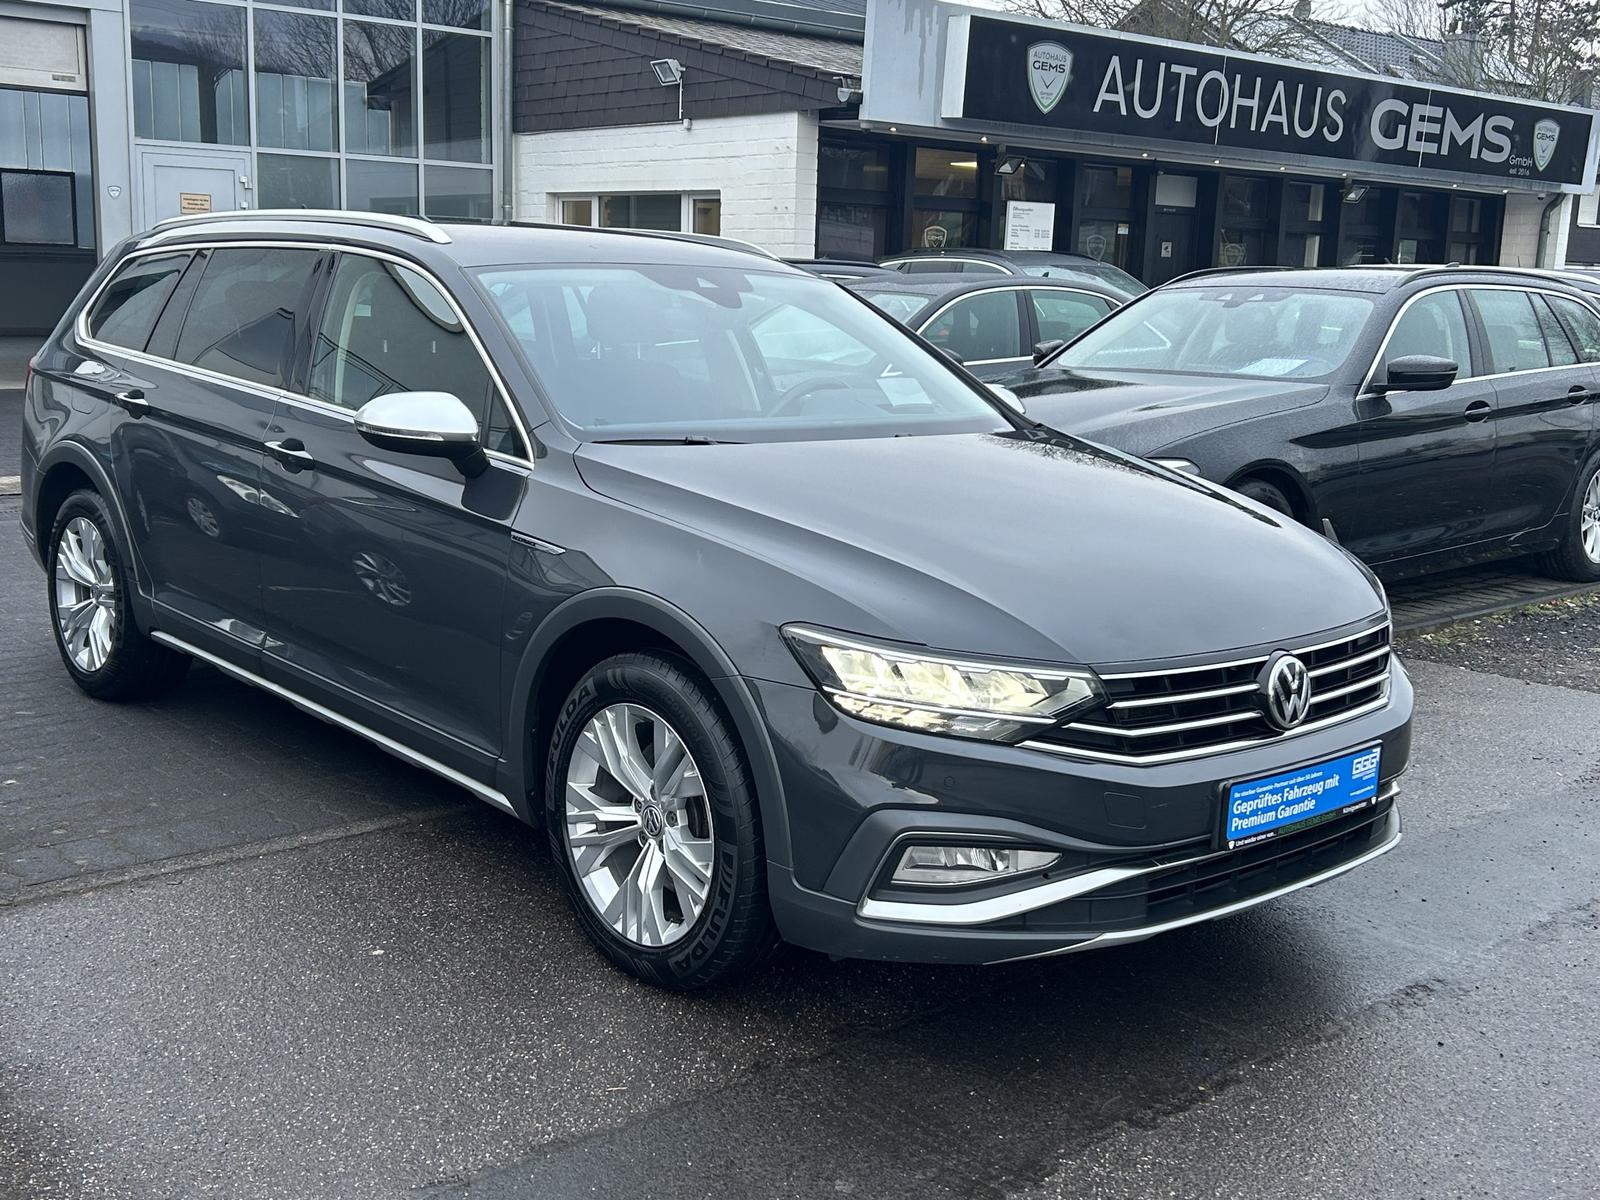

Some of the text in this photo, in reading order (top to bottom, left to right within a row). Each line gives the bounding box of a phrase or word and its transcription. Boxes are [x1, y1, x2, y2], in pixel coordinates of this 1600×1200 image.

[1033, 51, 1067, 63] AUTOHAUS
[1033, 60, 1066, 73] GEMS
[1093, 55, 1515, 163] AUTOHAUS GEMS
[1537, 133, 1556, 142] GEMS
[1509, 154, 1533, 167] GmbH
[1518, 167, 1530, 176] 2016
[549, 683, 593, 765] FULDA
[1233, 792, 1283, 815] Geprüftes
[1283, 781, 1324, 802] Fahrzeug
[1324, 773, 1340, 790] mit
[1231, 797, 1316, 832] Premium Garantie
[674, 891, 736, 971] FULDA
